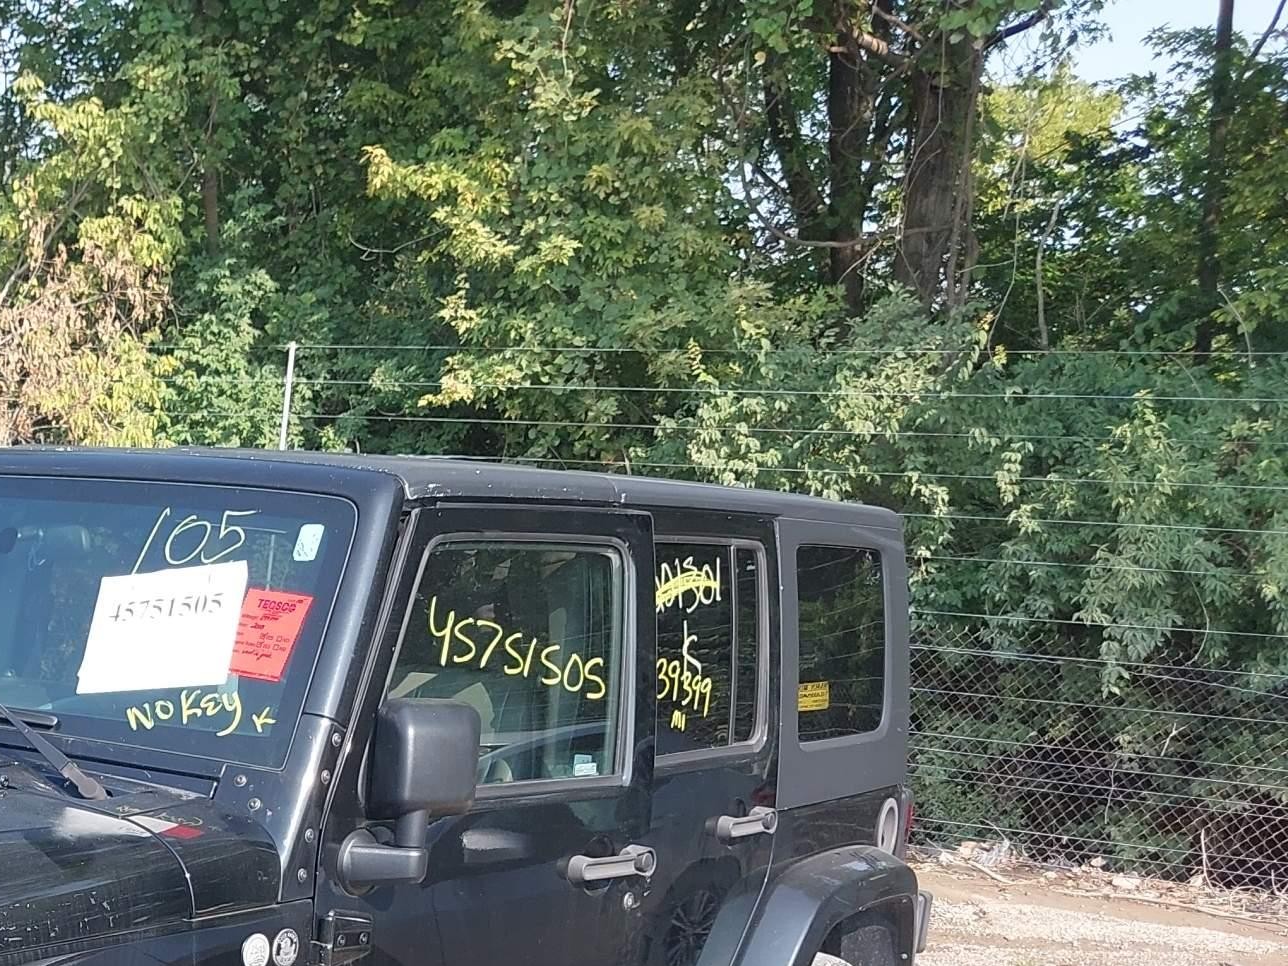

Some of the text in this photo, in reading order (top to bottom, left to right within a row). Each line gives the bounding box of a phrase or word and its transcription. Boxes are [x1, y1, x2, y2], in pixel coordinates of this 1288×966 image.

[130, 506, 261, 575] 105
[108, 592, 224, 623] 45751505
[429, 595, 607, 700] 45751505
[656, 658, 713, 718] 39399
